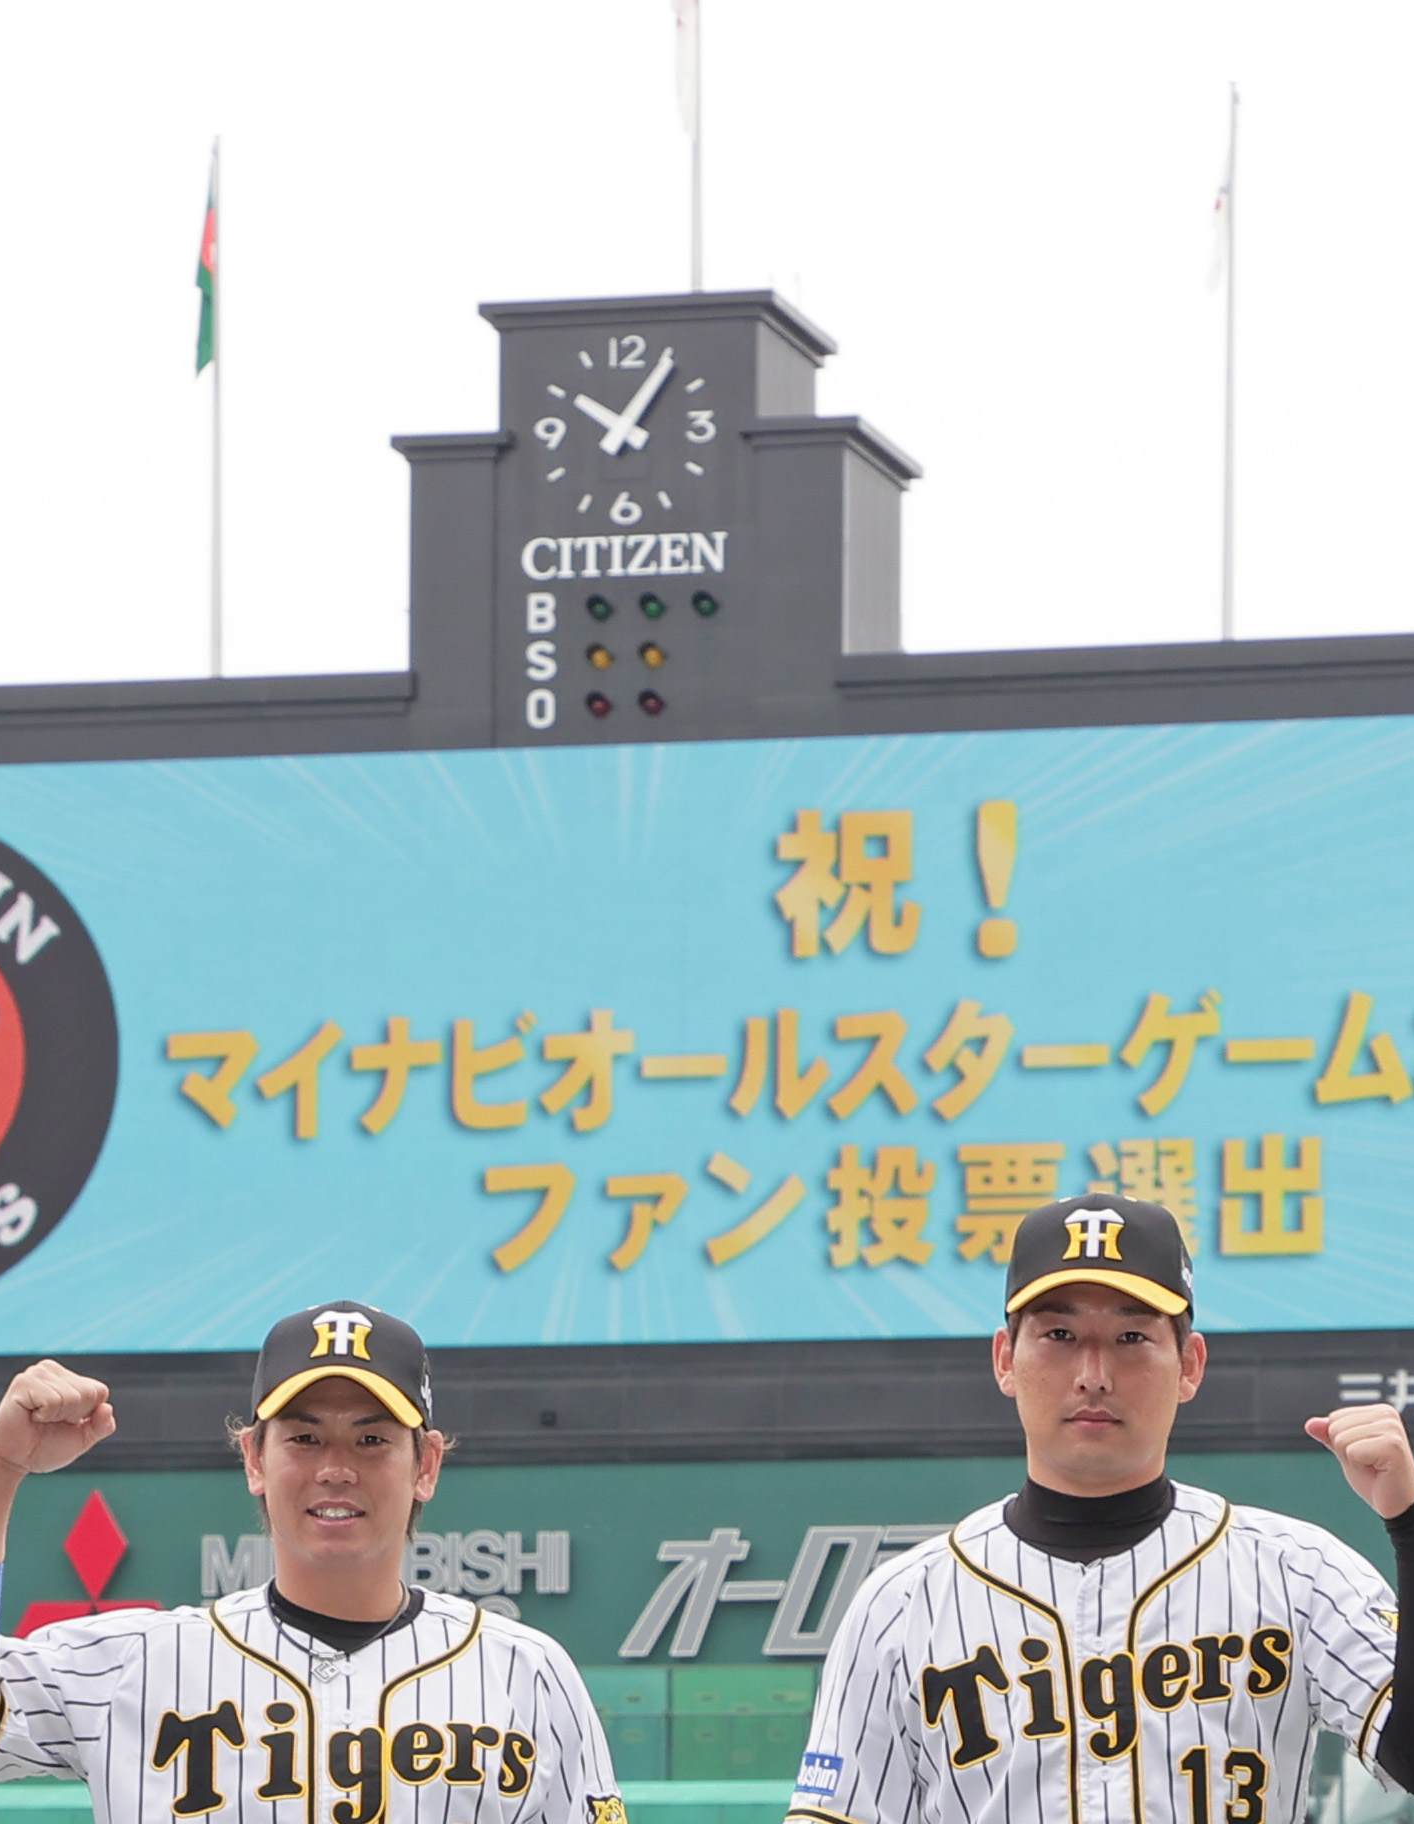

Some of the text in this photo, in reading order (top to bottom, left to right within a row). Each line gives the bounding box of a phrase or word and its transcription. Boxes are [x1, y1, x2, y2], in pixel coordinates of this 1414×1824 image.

[608, 335, 646, 369] 12
[533, 416, 567, 449] 9
[686, 409, 716, 443] 3
[609, 491, 643, 525] 6
[521, 531, 728, 580] CITIZEN
[527, 593, 557, 634] B
[526, 640, 557, 681] S
[201, 1530, 570, 1600] MIBISHI
[920, 1625, 1293, 1770] Tigers
